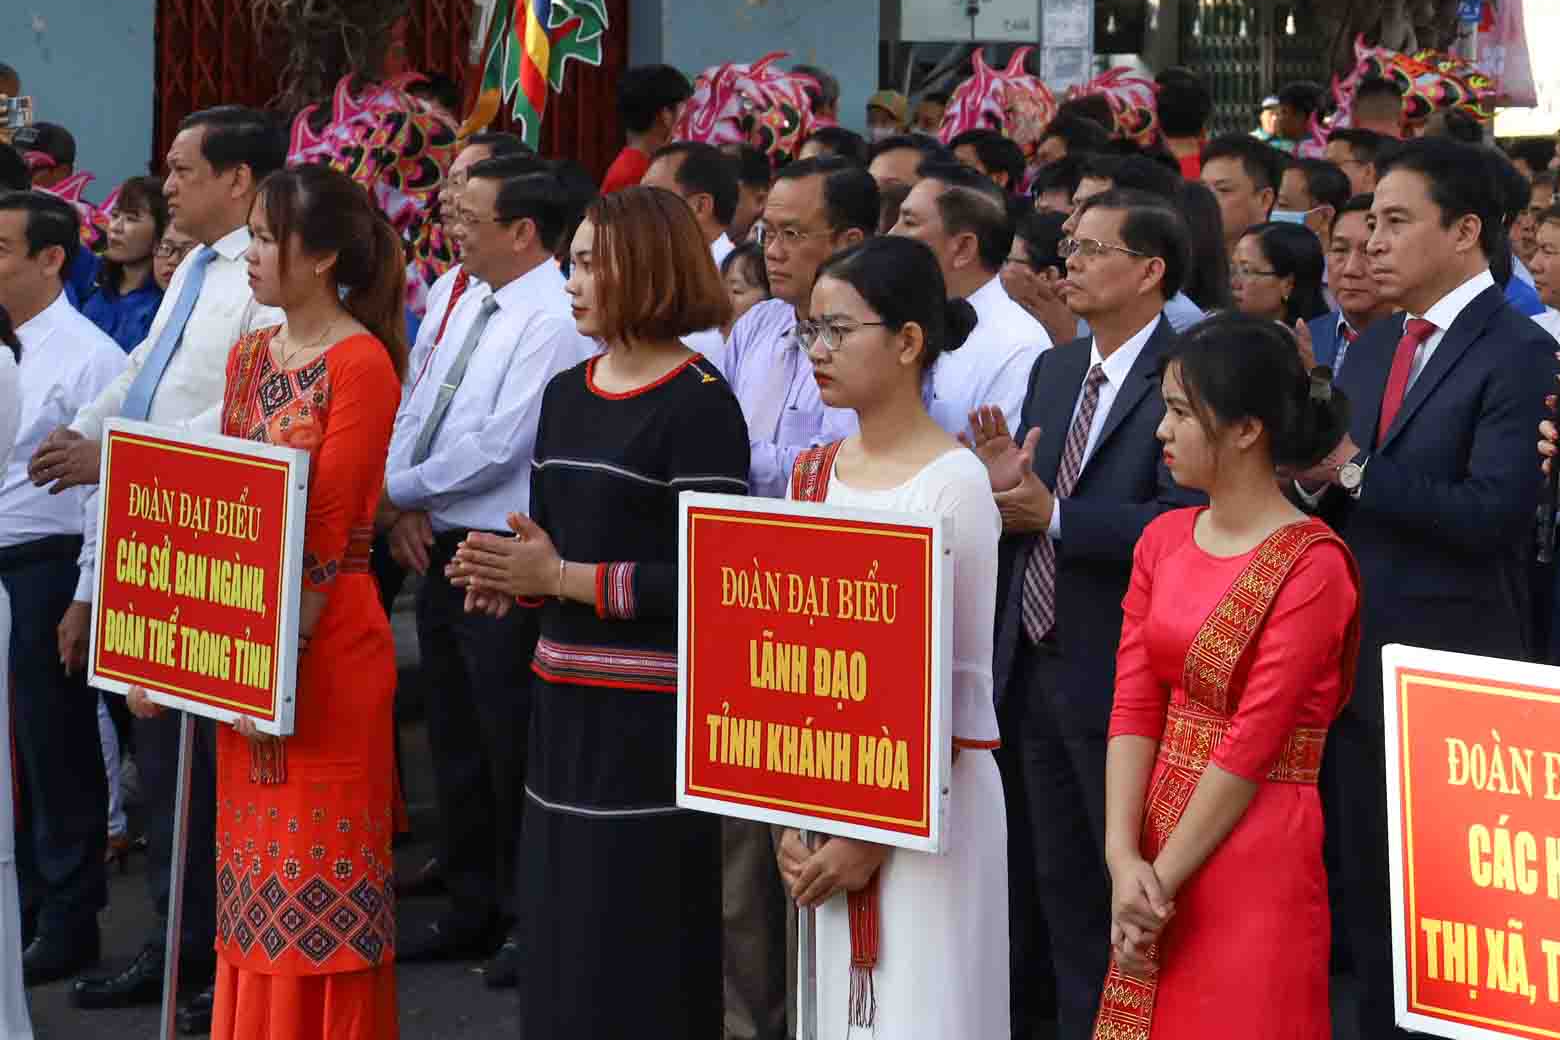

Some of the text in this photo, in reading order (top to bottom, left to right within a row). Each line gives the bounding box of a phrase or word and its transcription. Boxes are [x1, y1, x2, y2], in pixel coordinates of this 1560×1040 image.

[128, 476, 262, 542] ĐOÀN ĐẠI BIỂU
[116, 531, 267, 618] CÁC SỞ, BAN NGÀNH,
[720, 557, 899, 626] ĐOÀN ĐẠI BIỂU
[104, 603, 272, 690] ĐOÀN THỂ TRONG TỈNH
[749, 629, 868, 711] LÃNH ĐẠO
[706, 701, 910, 792] TỈNH KHÁNH HÒA
[1445, 728, 1534, 801] ĐOÀN
[1467, 814, 1539, 895] CÁC
[1421, 917, 1479, 1000] THỊ
[1485, 920, 1537, 1005] XÃ,
